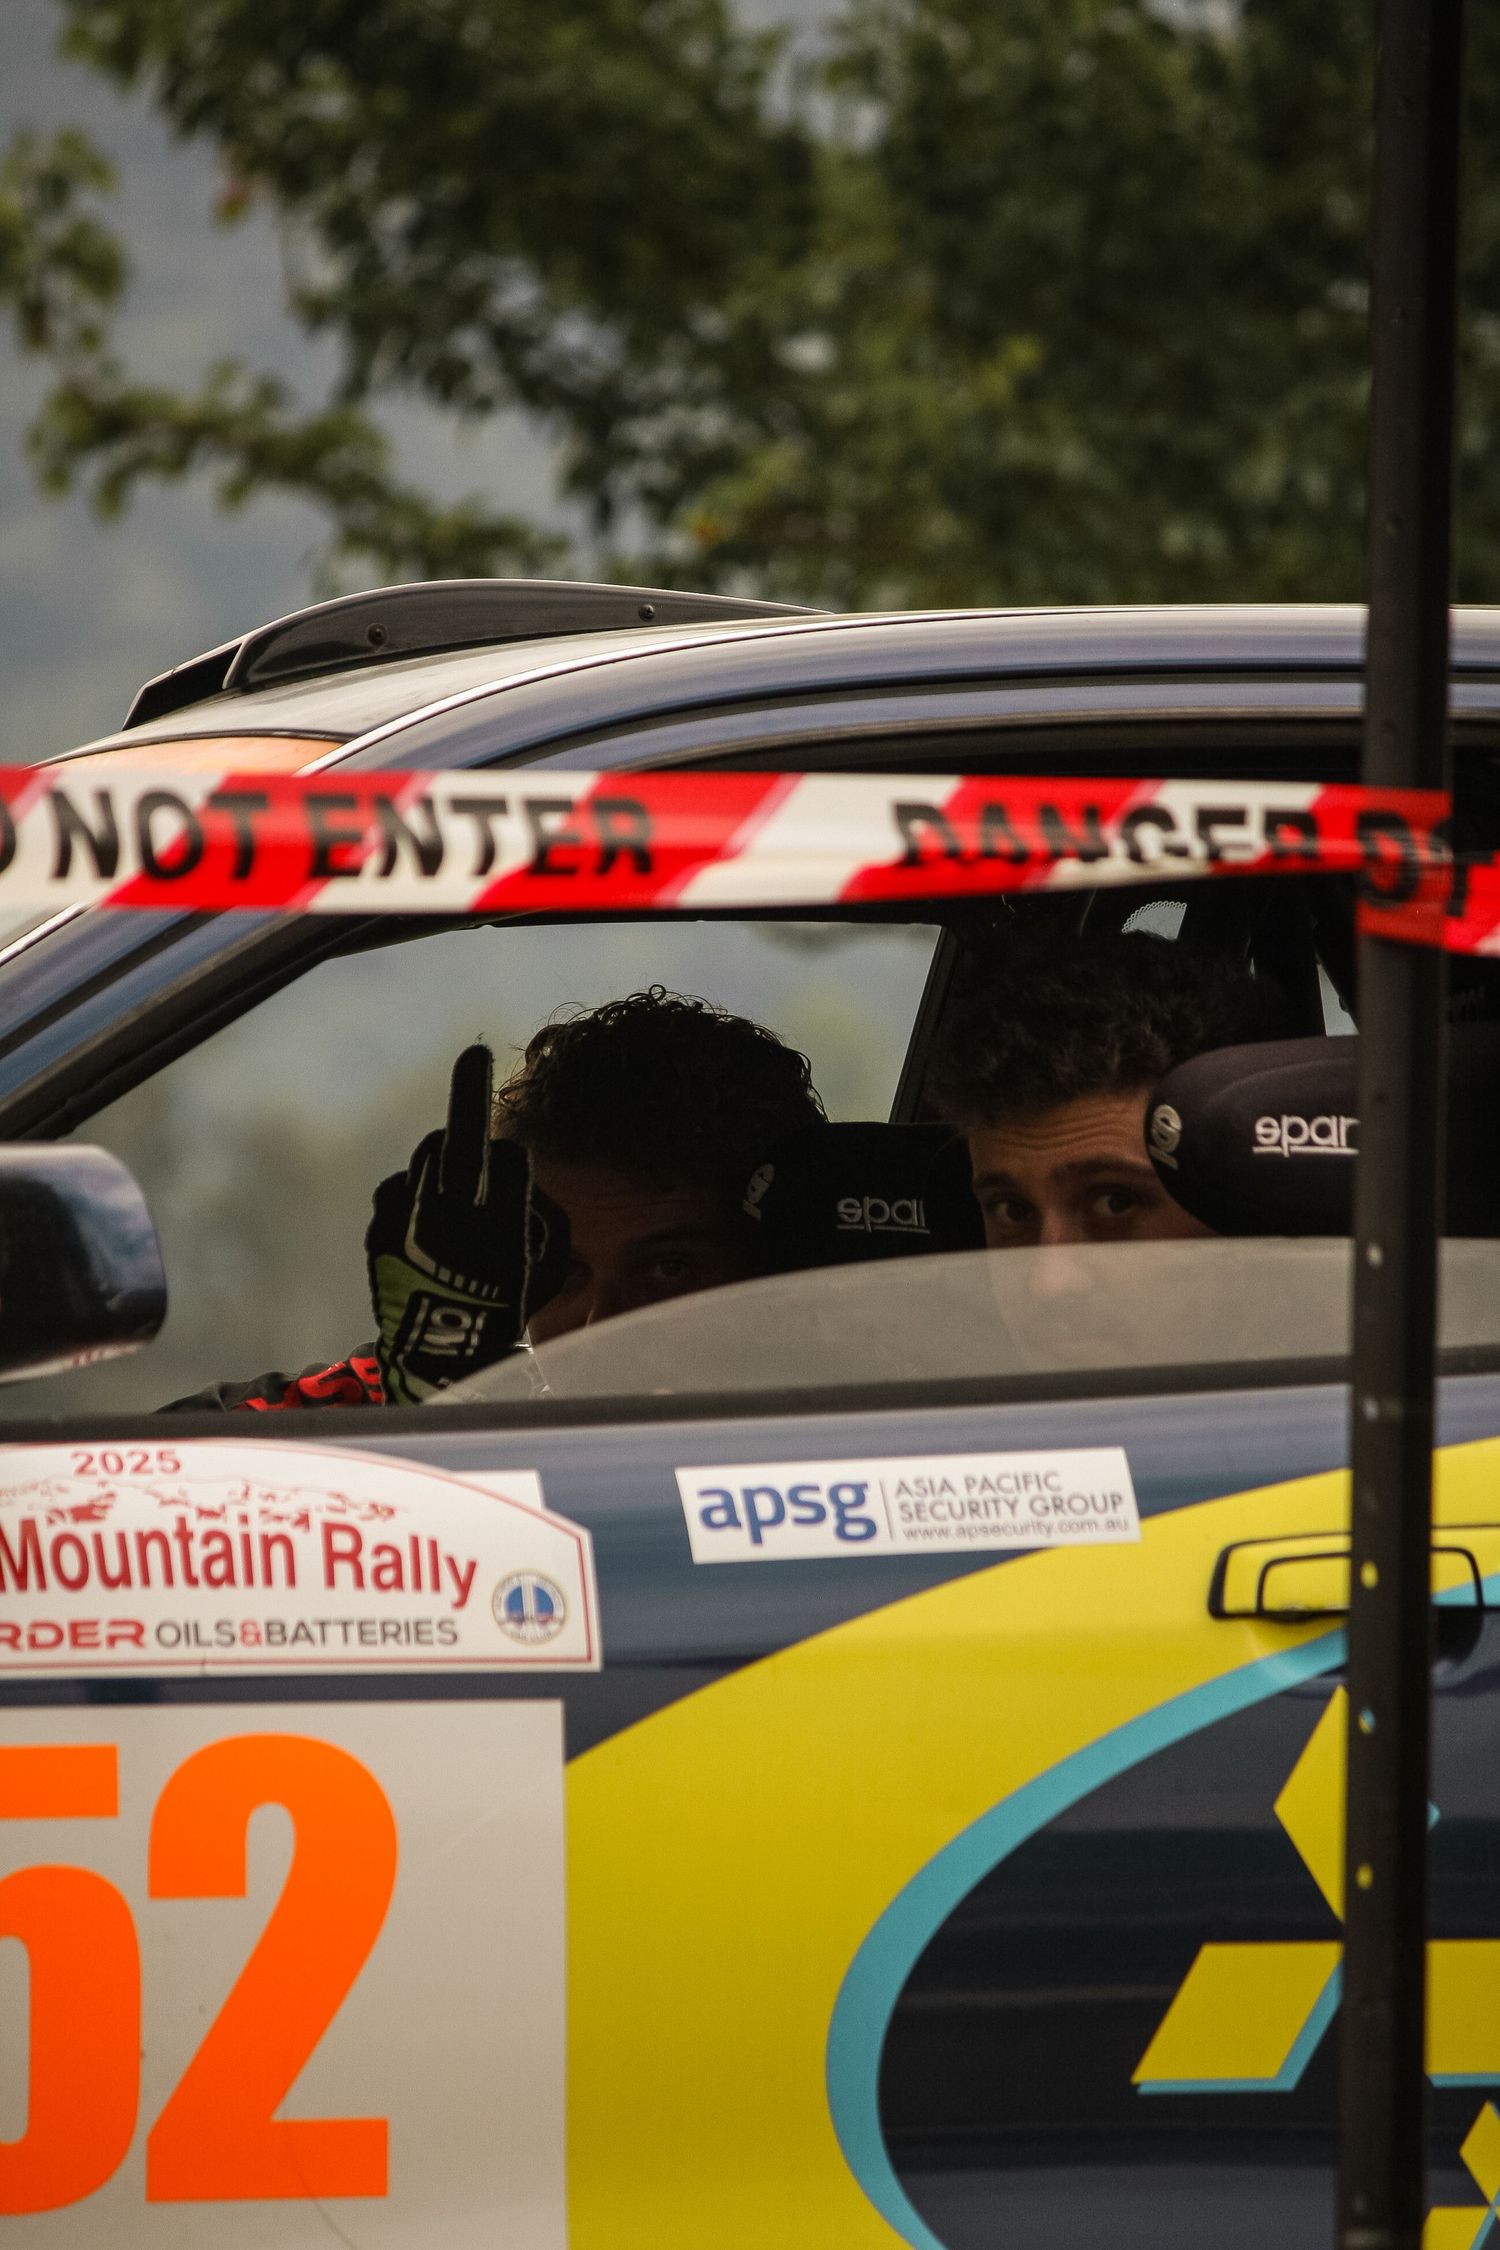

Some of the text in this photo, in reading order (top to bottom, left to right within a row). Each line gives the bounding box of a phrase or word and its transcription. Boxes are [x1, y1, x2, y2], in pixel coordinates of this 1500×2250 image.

[49, 789, 269, 881] NOT
[303, 791, 654, 879] ENTER
[70, 1450, 183, 1475] 2025
[895, 1471, 1063, 1498] ASIA PACIFIC
[696, 1481, 877, 1546] apsg
[899, 1493, 1124, 1523] SECURITY GROUP
[0, 1514, 297, 1593] Mountain
[320, 1521, 478, 1609] Rally
[0, 1732, 398, 2217] 52
